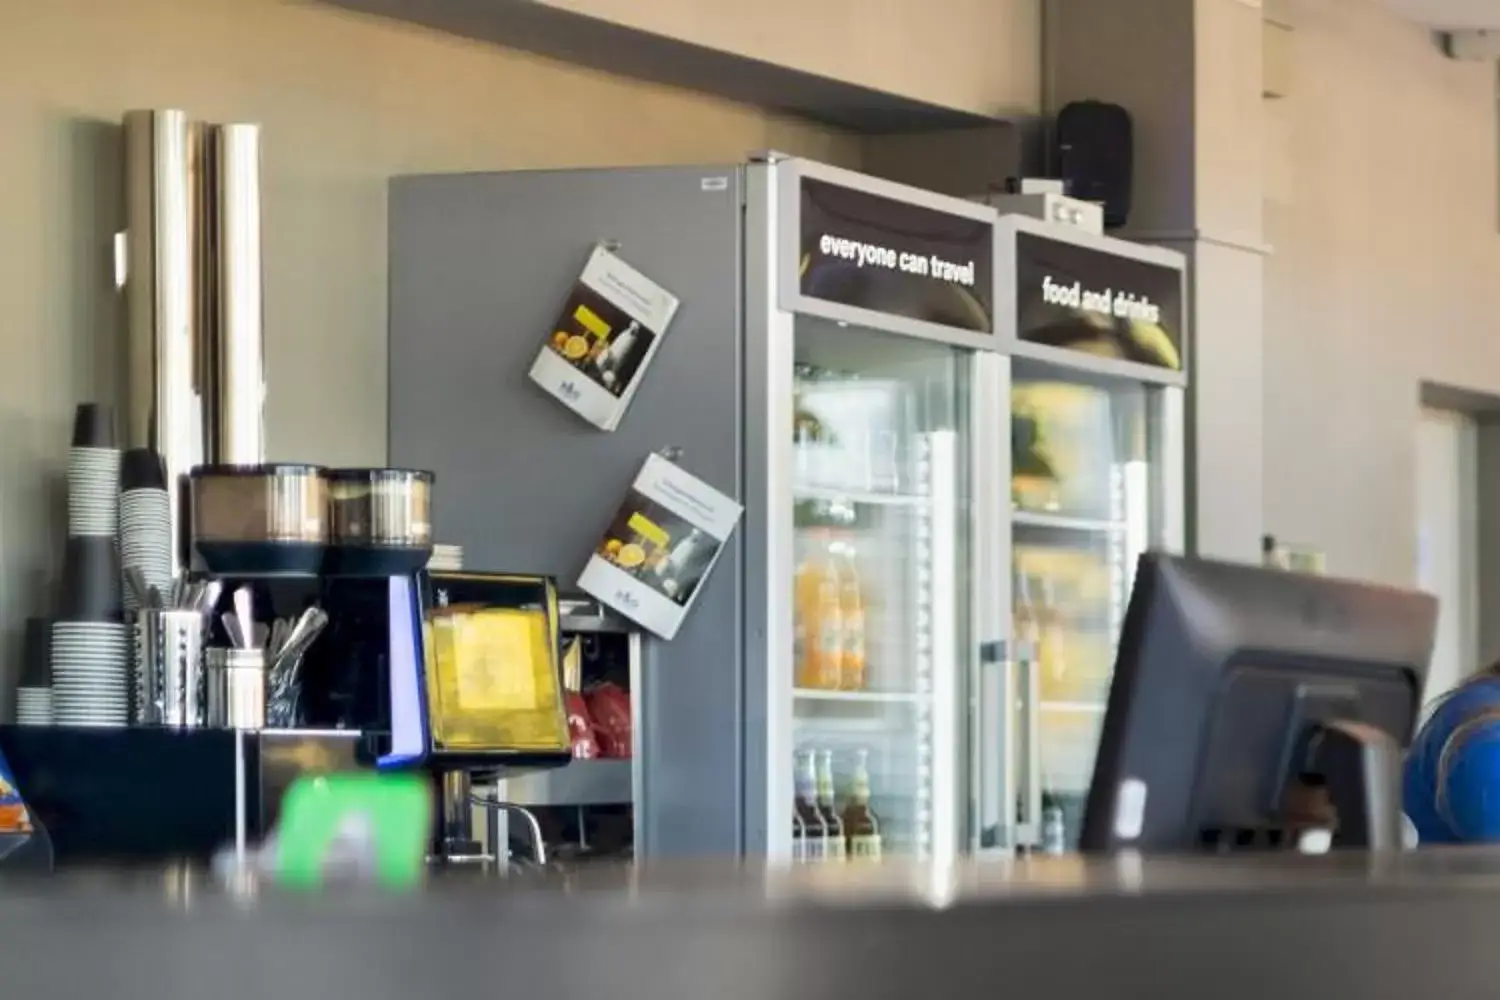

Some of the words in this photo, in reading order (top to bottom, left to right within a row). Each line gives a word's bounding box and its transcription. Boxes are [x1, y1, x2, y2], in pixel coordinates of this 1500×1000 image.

[819, 234, 896, 268] everyone
[899, 251, 928, 276] can
[930, 255, 974, 286] travel
[1042, 275, 1080, 308] food
[1081, 288, 1112, 314] and
[1113, 291, 1159, 323] drinks
